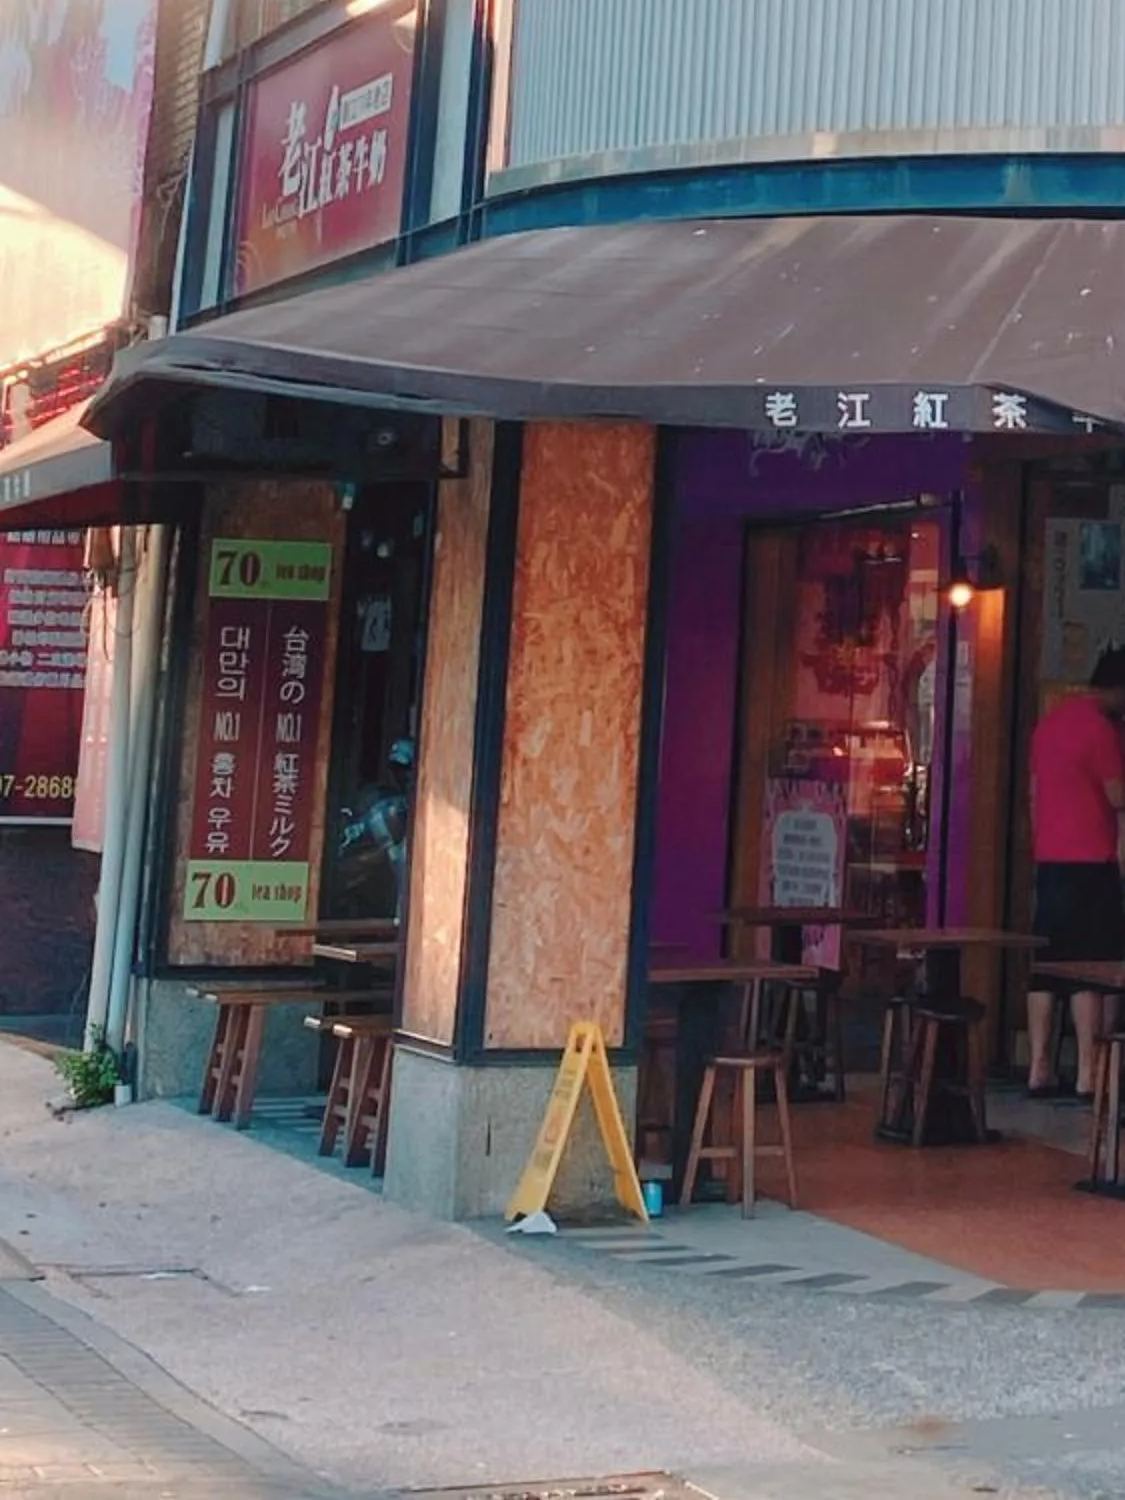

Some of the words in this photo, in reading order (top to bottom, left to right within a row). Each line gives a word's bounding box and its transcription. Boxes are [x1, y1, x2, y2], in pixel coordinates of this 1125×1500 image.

[216, 550, 262, 586] 70
[215, 626, 250, 700] 대만의
[0, 775, 77, 799] 7-2868
[205, 807, 232, 854] 우유
[191, 872, 236, 909] 70
